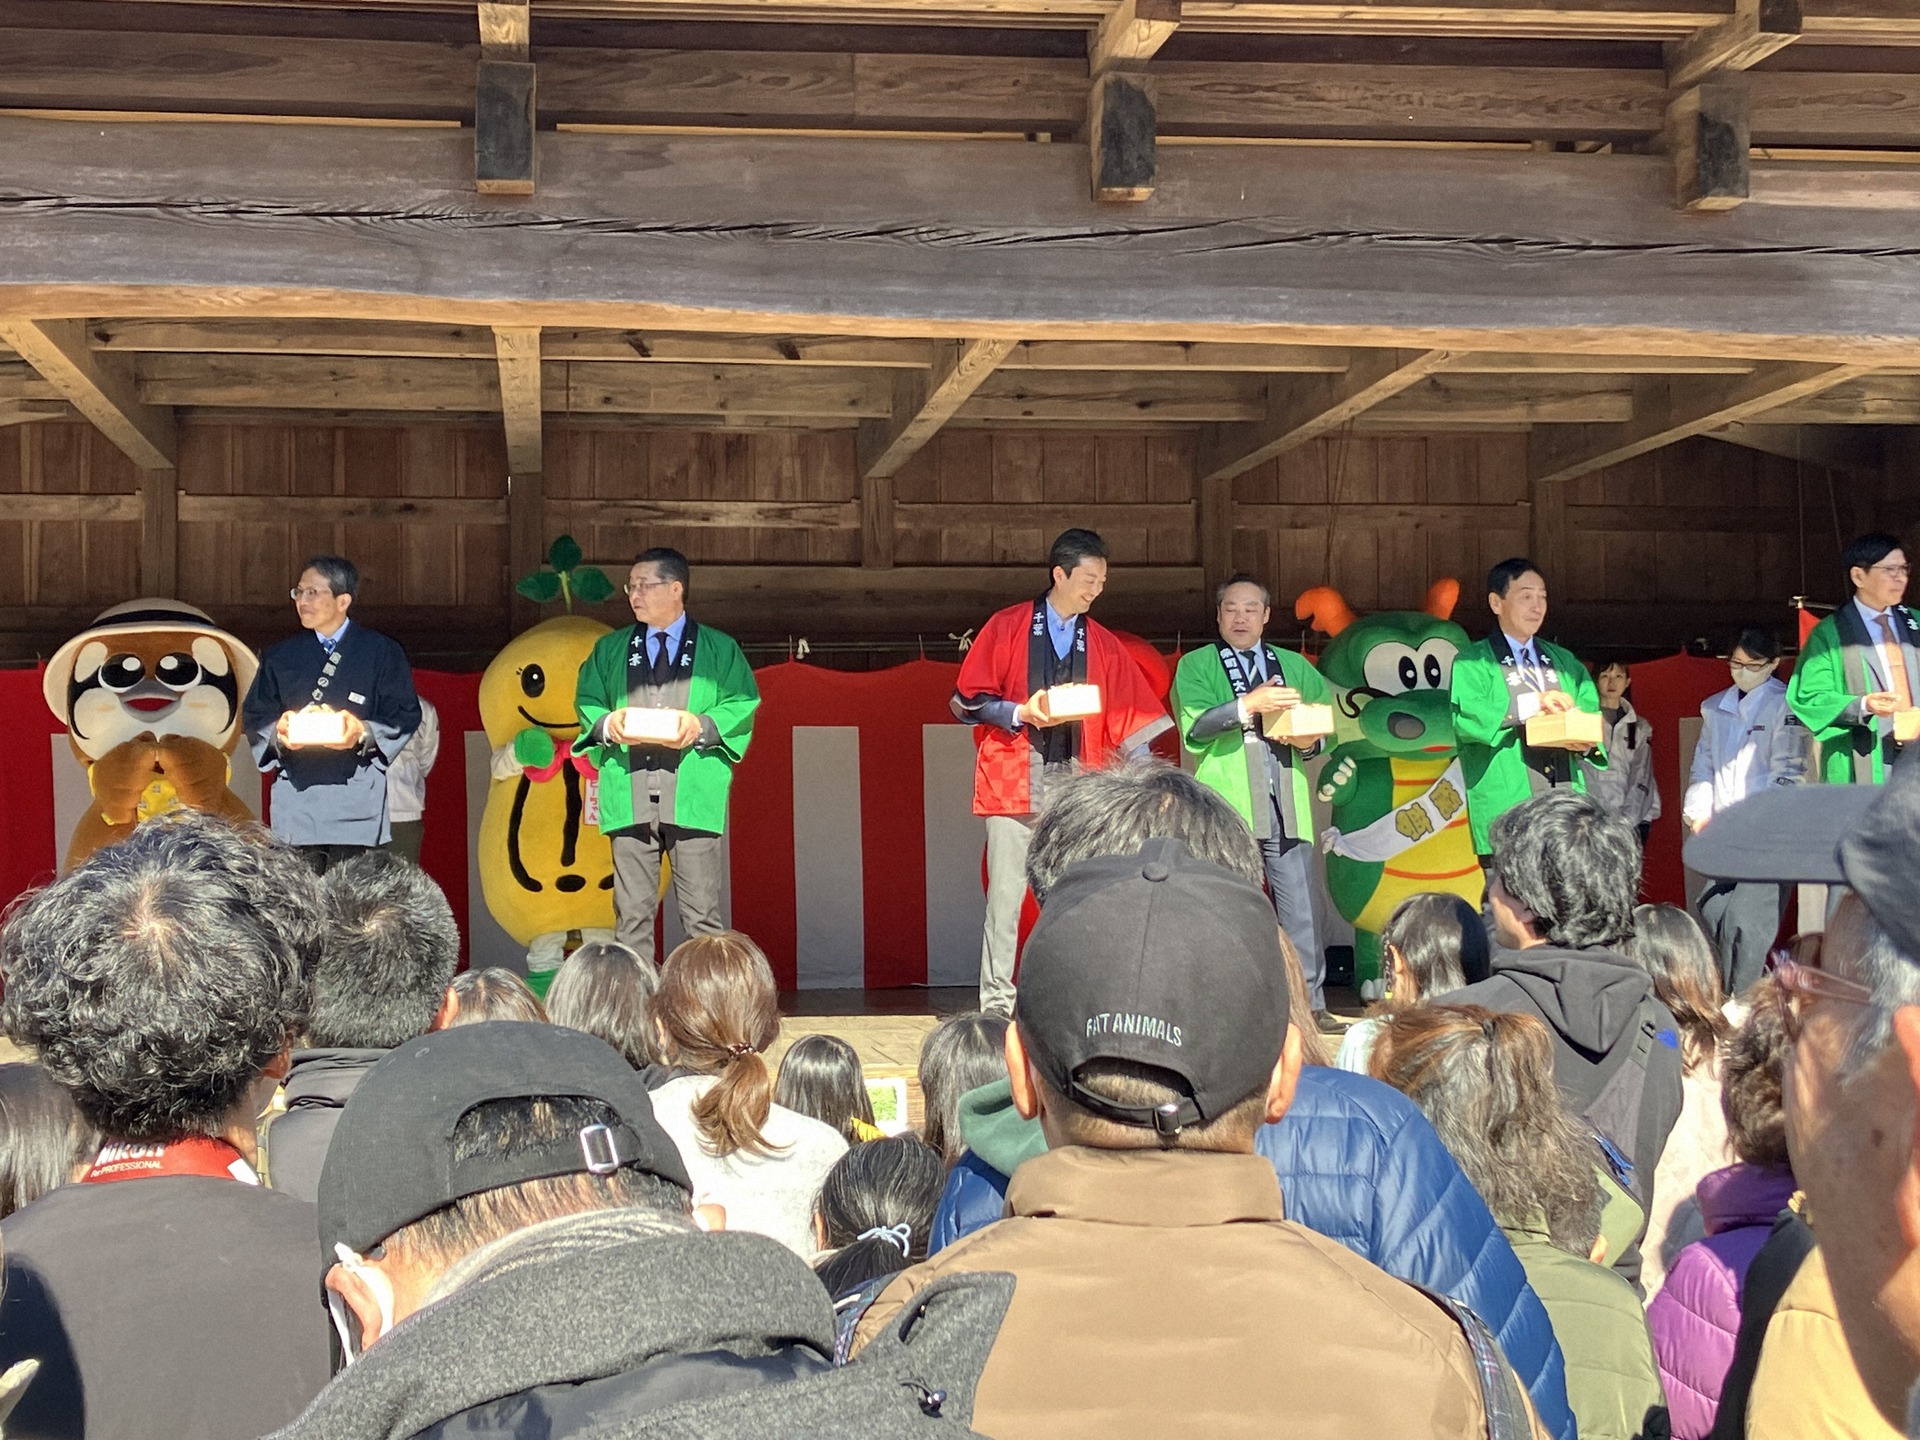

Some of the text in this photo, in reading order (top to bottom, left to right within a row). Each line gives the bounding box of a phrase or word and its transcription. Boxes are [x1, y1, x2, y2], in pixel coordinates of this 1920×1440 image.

[1033, 611, 1044, 636] 千葉
[1076, 628, 1086, 653] 千葉
[1086, 1012, 1183, 1048] FAT ANIMALS
[101, 1160, 163, 1174] PROFESSIONAL
